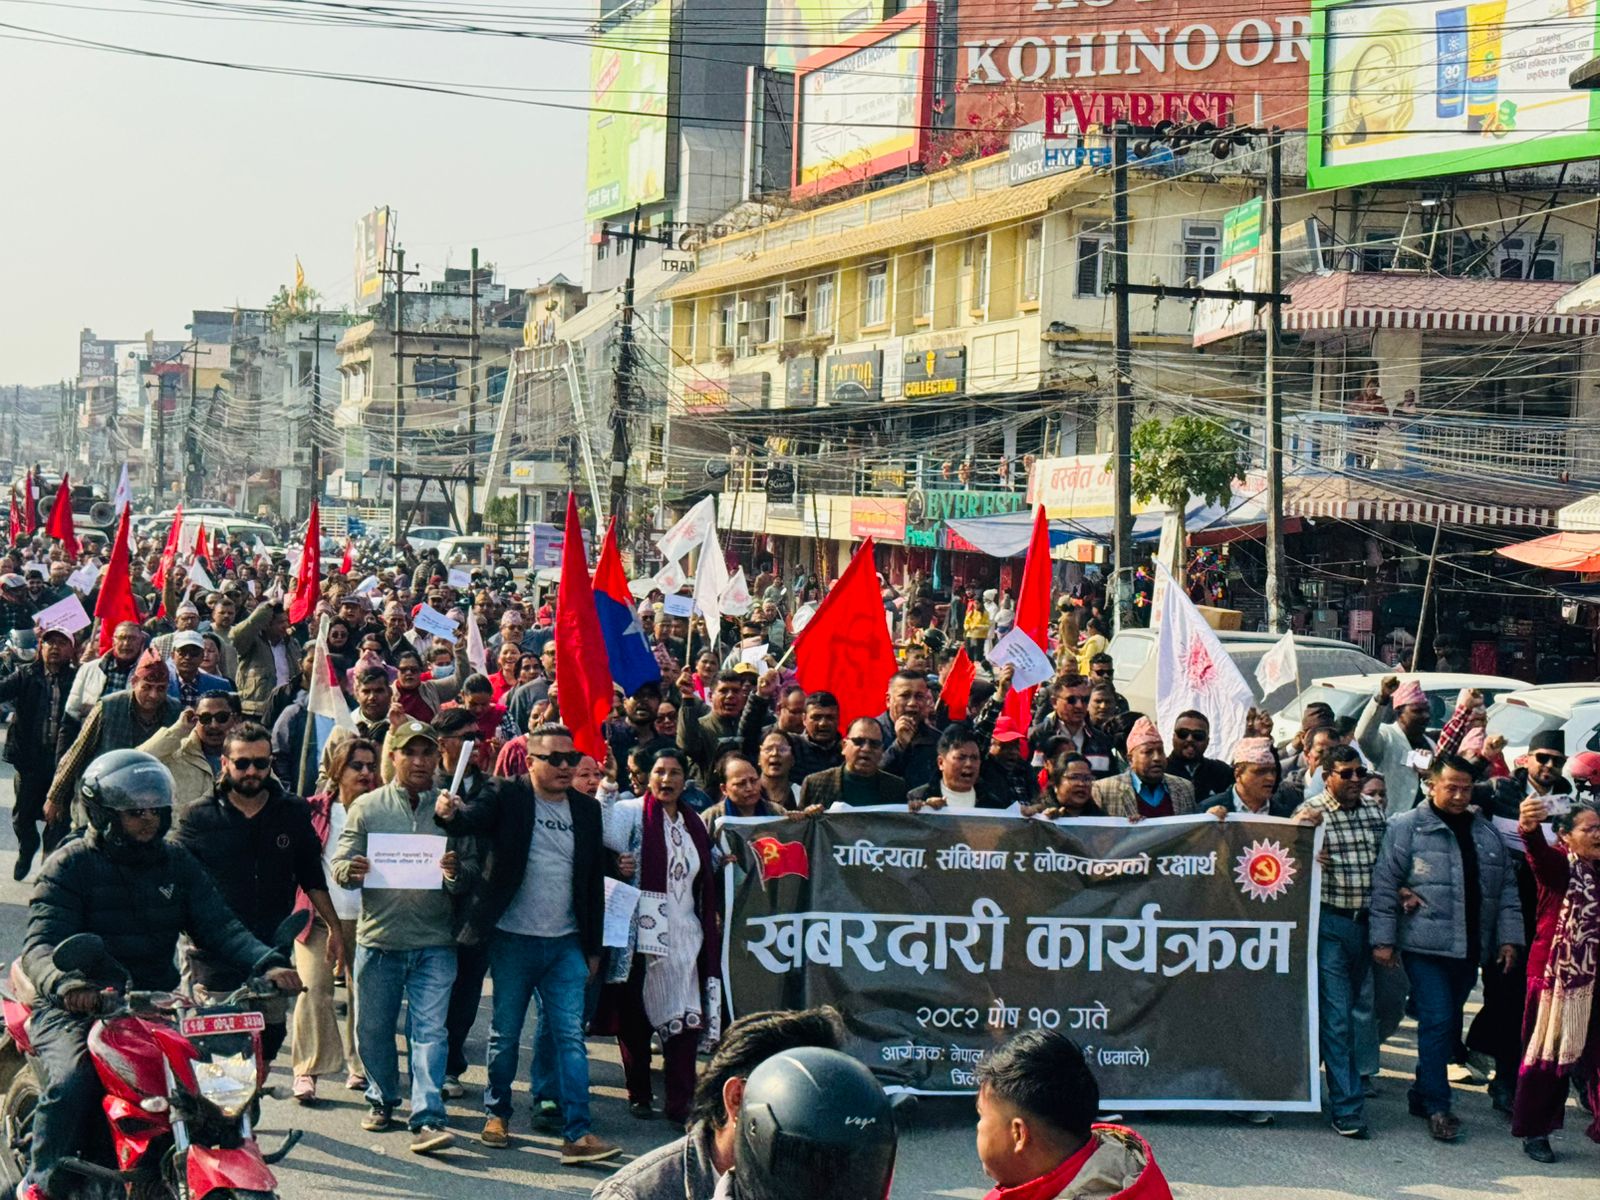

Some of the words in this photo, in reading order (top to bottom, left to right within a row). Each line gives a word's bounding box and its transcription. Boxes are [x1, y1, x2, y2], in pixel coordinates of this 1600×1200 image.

[964, 15, 1312, 85] KOHINOOR
[1043, 91, 1235, 139] EVEREST
[831, 360, 873, 392] TATTOO
[904, 377, 957, 399] COLLECTION
[926, 491, 1022, 520] EVEREST
[936, 843, 1008, 871] संविधान
[1014, 851, 1029, 873] र
[1034, 846, 1150, 876] लोकतन्त्रको
[1157, 849, 1217, 877] रक्षार्थ
[746, 897, 1010, 976] खबरदारी
[1027, 903, 1297, 978] कार्यक्रम
[916, 1006, 979, 1029] २०८२
[987, 998, 1019, 1029] पौष
[1029, 1007, 1060, 1029] १०
[1069, 1001, 1110, 1030] गते
[950, 1044, 984, 1065] नेपाल
[1097, 1046, 1150, 1067] (एमाले)
